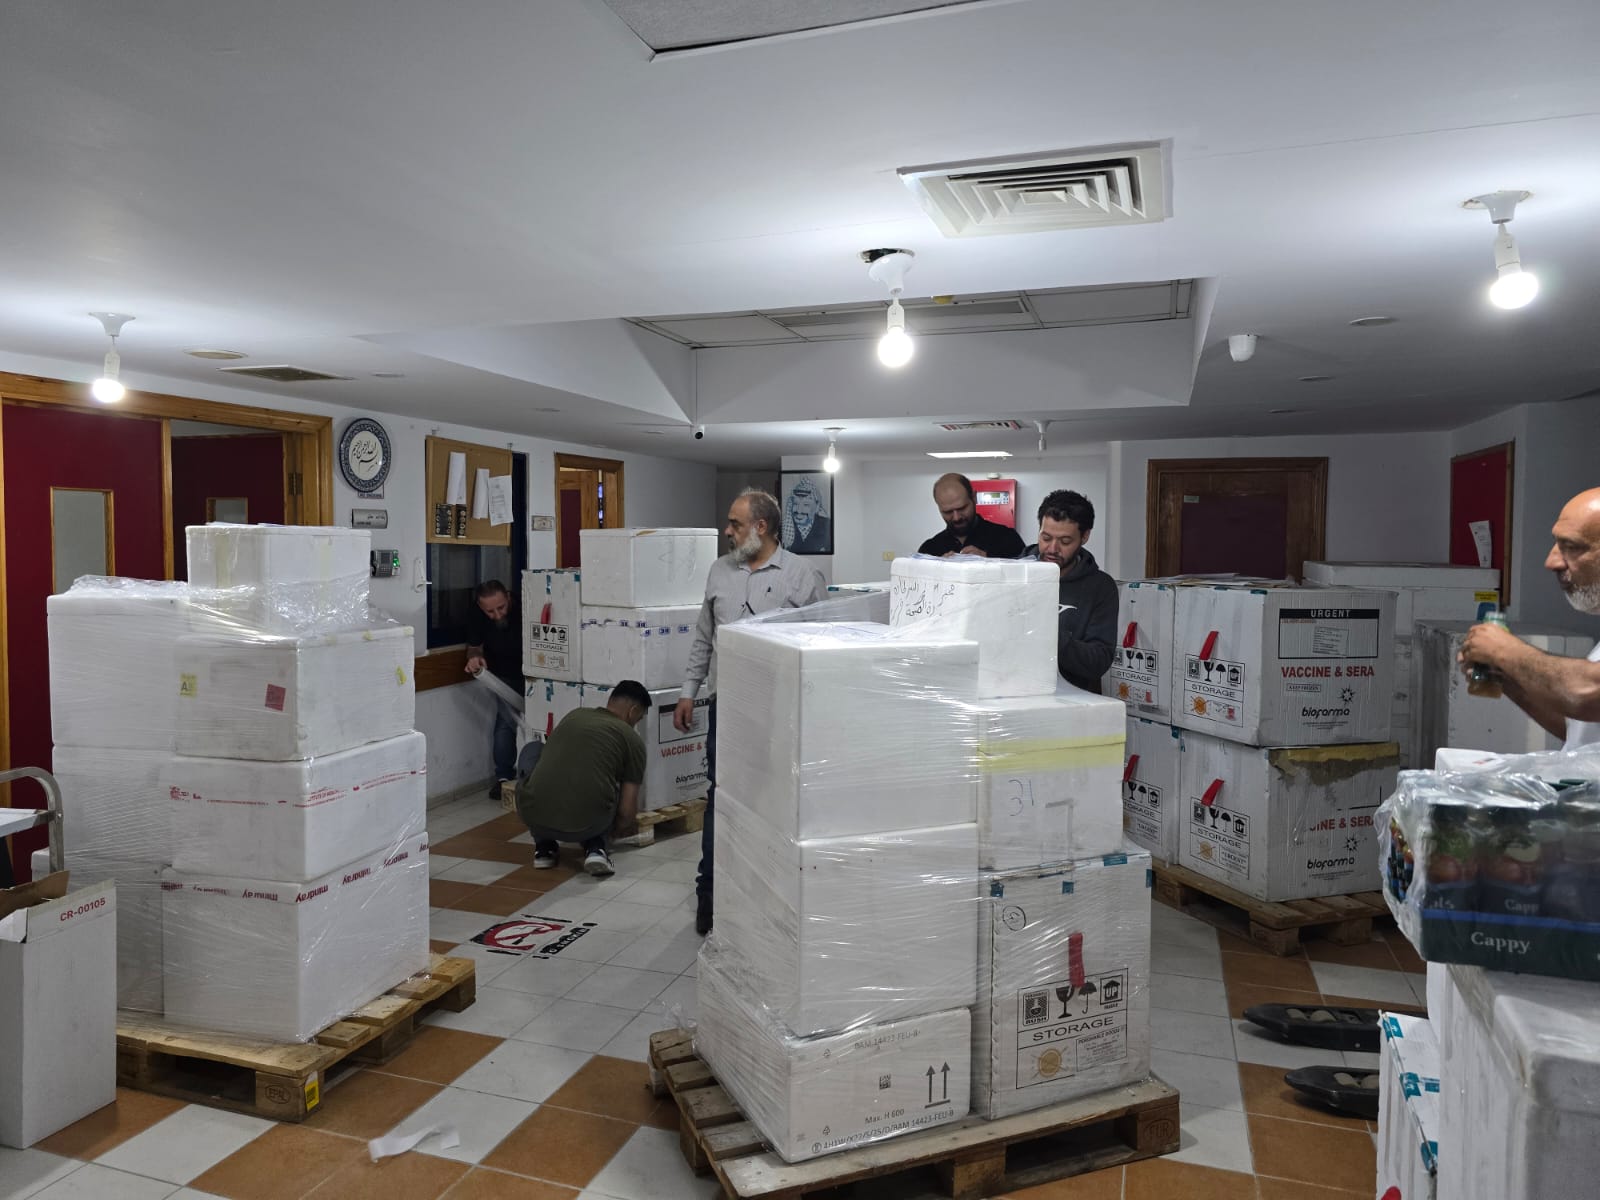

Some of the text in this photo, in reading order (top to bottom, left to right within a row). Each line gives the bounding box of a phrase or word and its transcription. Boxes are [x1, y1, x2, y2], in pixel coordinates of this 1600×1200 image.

[1310, 609, 1351, 618] URGENT
[1117, 671, 1152, 683] STORAGE
[1281, 665, 1375, 678] VACCINE & SERA
[1191, 684, 1236, 698] STORAGE
[1301, 706, 1350, 719] biofarma
[661, 742, 702, 758] VACCINE &
[1339, 817, 1346, 829] &
[1198, 828, 1242, 849] STORAGE
[295, 885, 329, 903] mindray
[60, 896, 106, 922] CR-00105
[1504, 899, 1540, 914] Capp
[1470, 931, 1530, 954] Cappy
[1105, 986, 1118, 998] UP
[1033, 1016, 1114, 1042] STORAGE
[884, 1112, 890, 1120] H
[891, 1108, 905, 1118] 600
